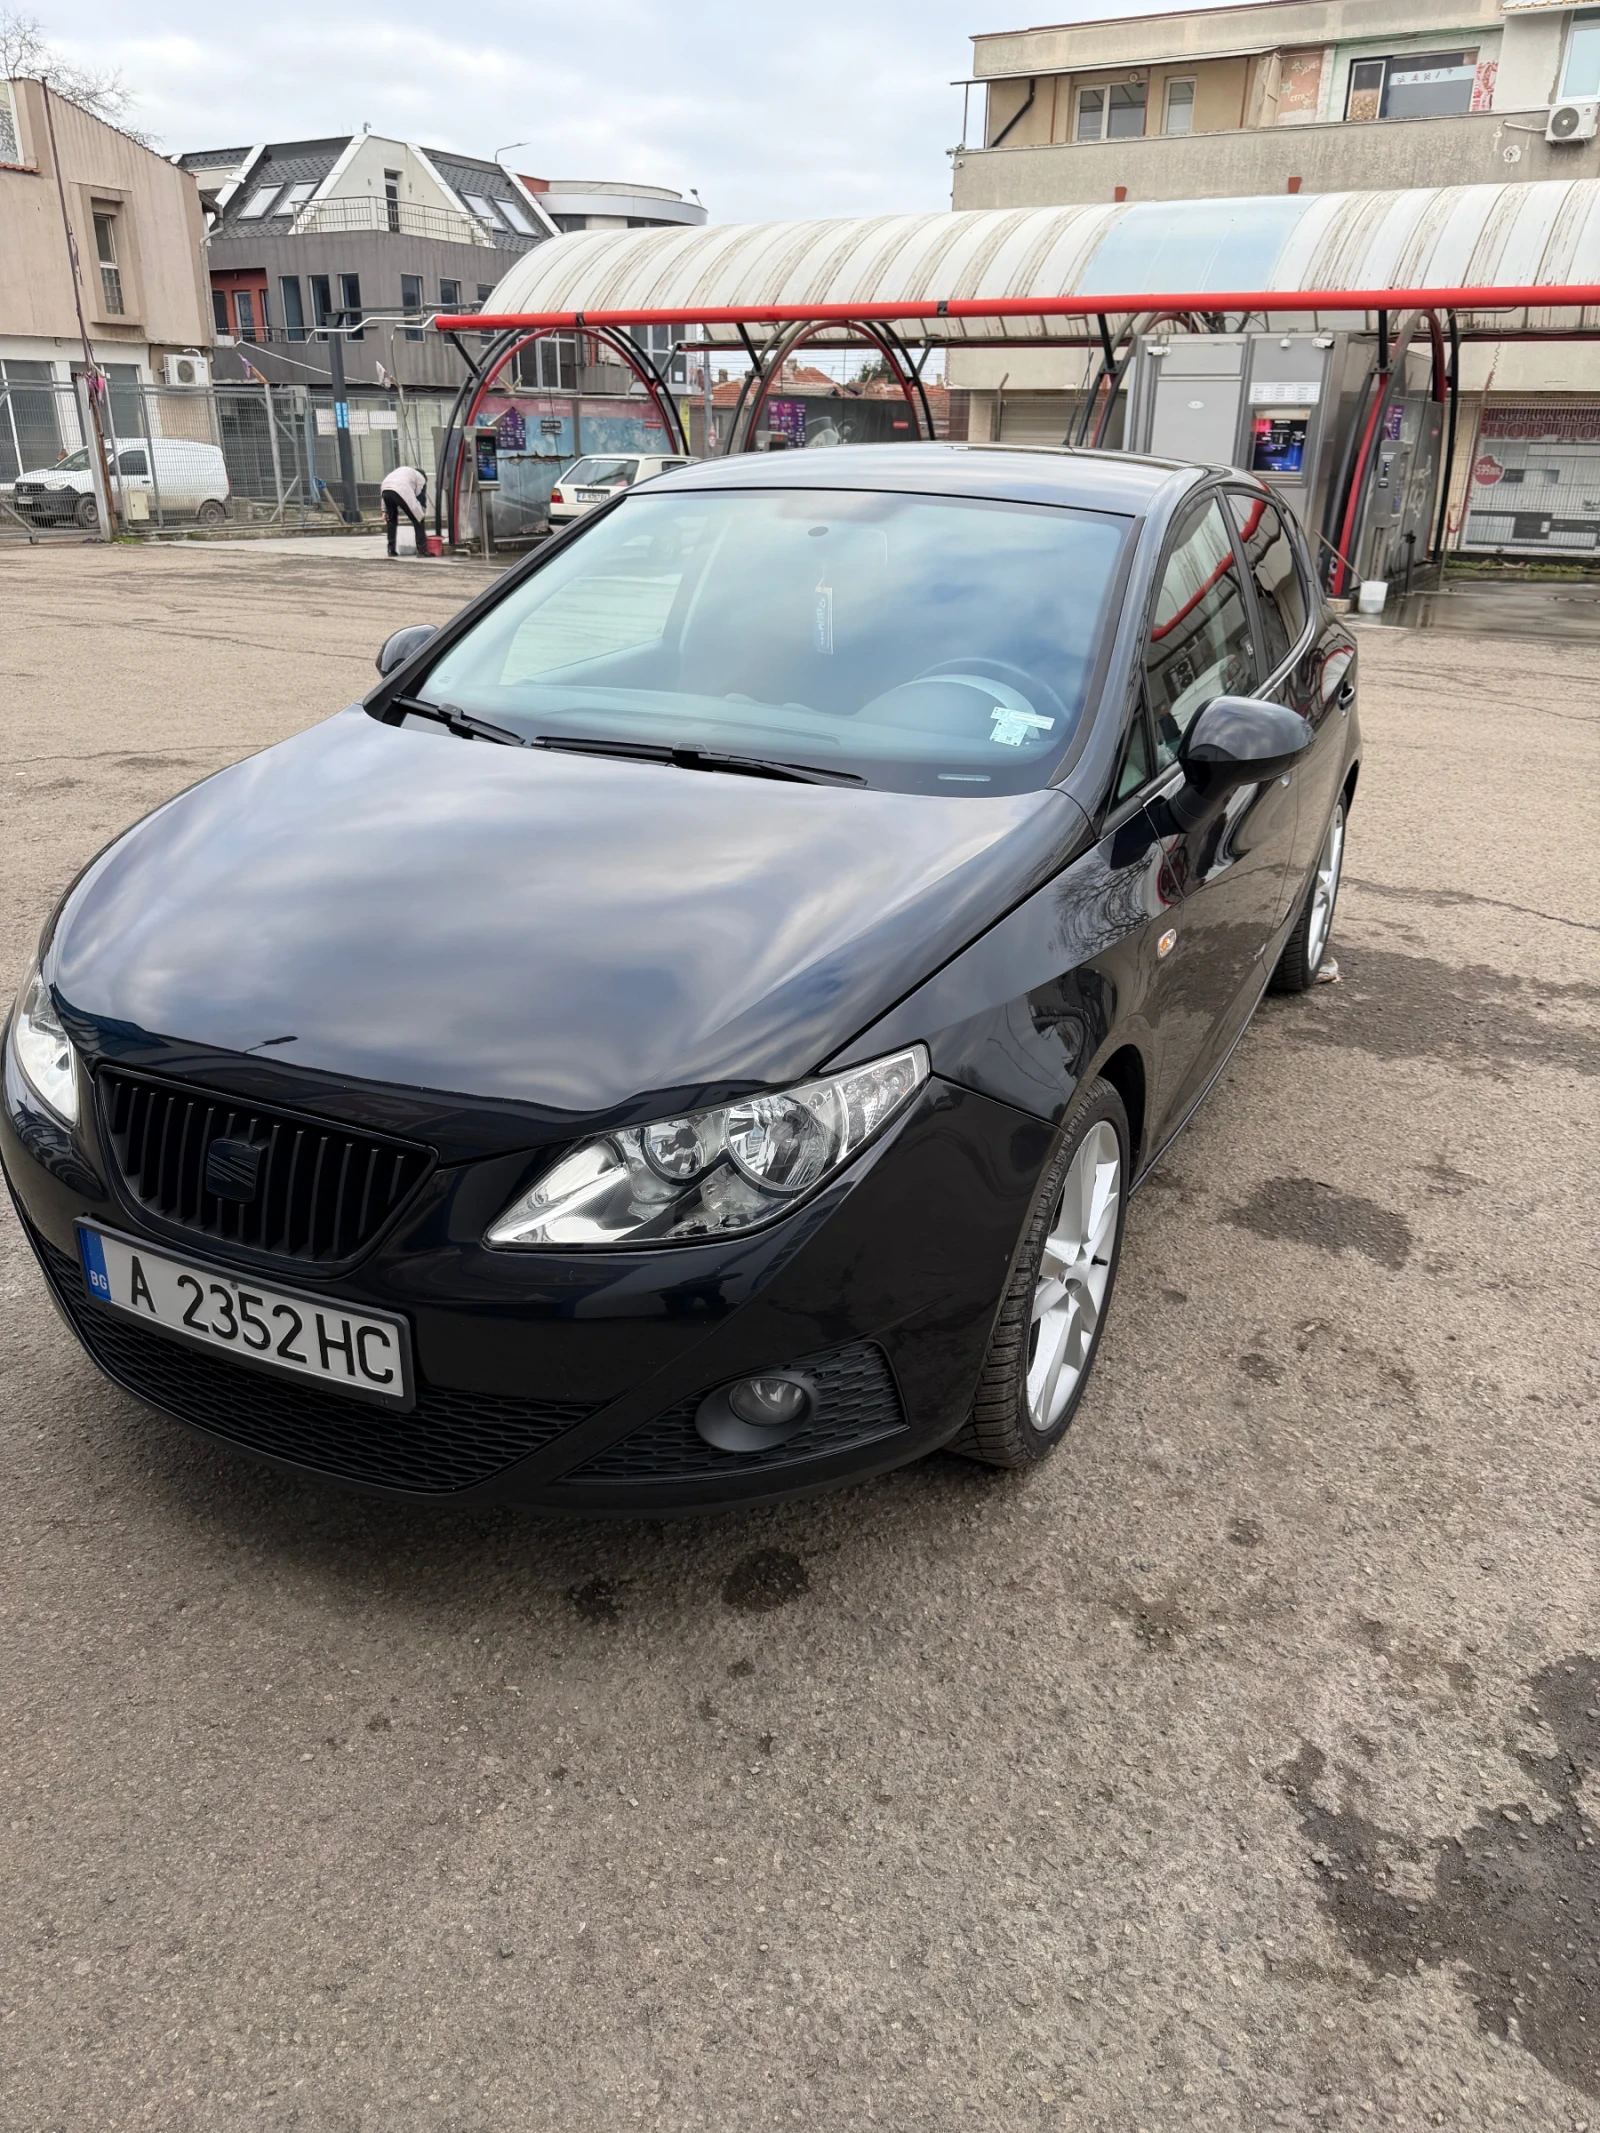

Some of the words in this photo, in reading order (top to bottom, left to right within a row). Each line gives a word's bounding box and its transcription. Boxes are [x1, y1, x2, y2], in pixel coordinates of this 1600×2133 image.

[1485, 422, 1545, 440] НОВ
[90, 1270, 108, 1290] BG
[131, 1255, 157, 1314] A
[177, 1274, 307, 1363] 2352
